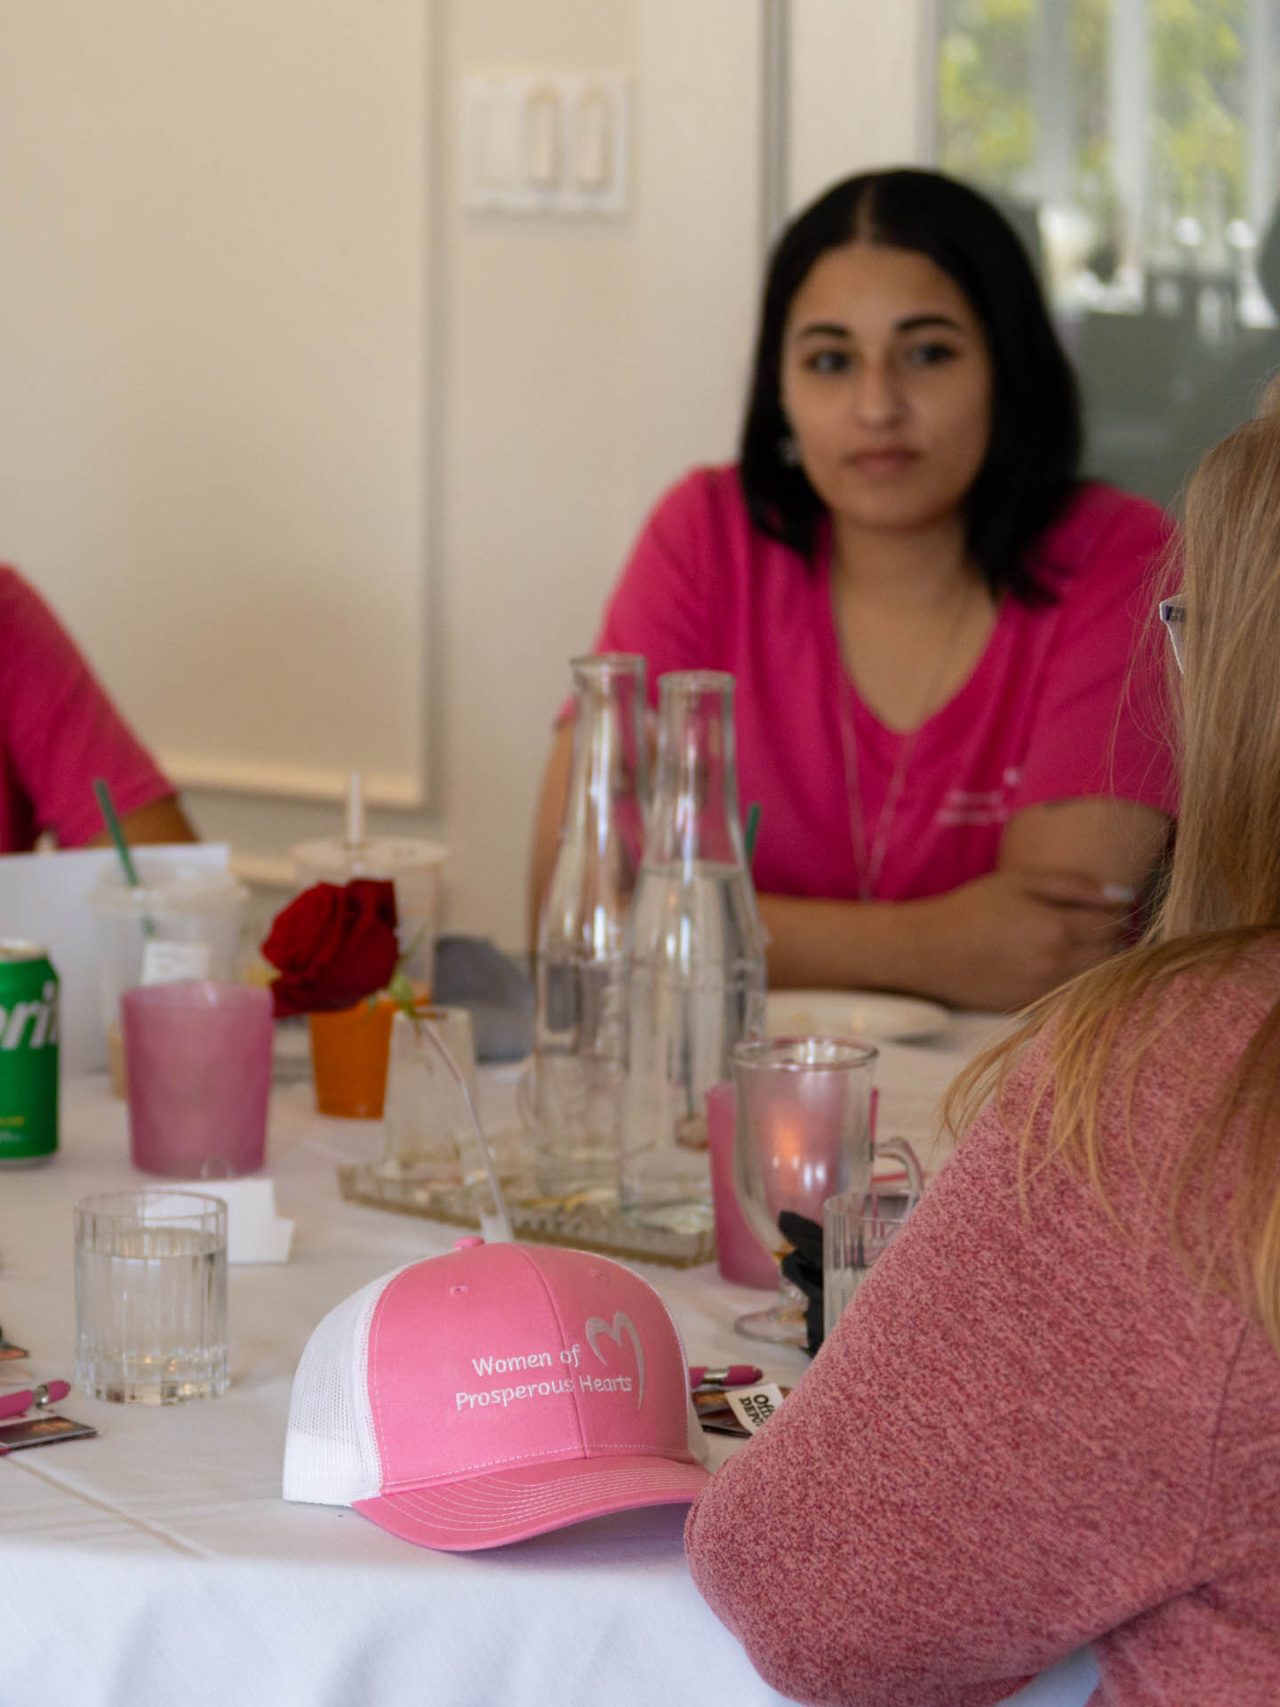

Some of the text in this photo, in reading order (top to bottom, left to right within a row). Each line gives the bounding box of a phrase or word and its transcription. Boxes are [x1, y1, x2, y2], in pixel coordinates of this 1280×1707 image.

[472, 1344, 581, 1377] Women of
[455, 1374, 632, 1411] Prosperous Hearts
[739, 1396, 764, 1427] DEPO
